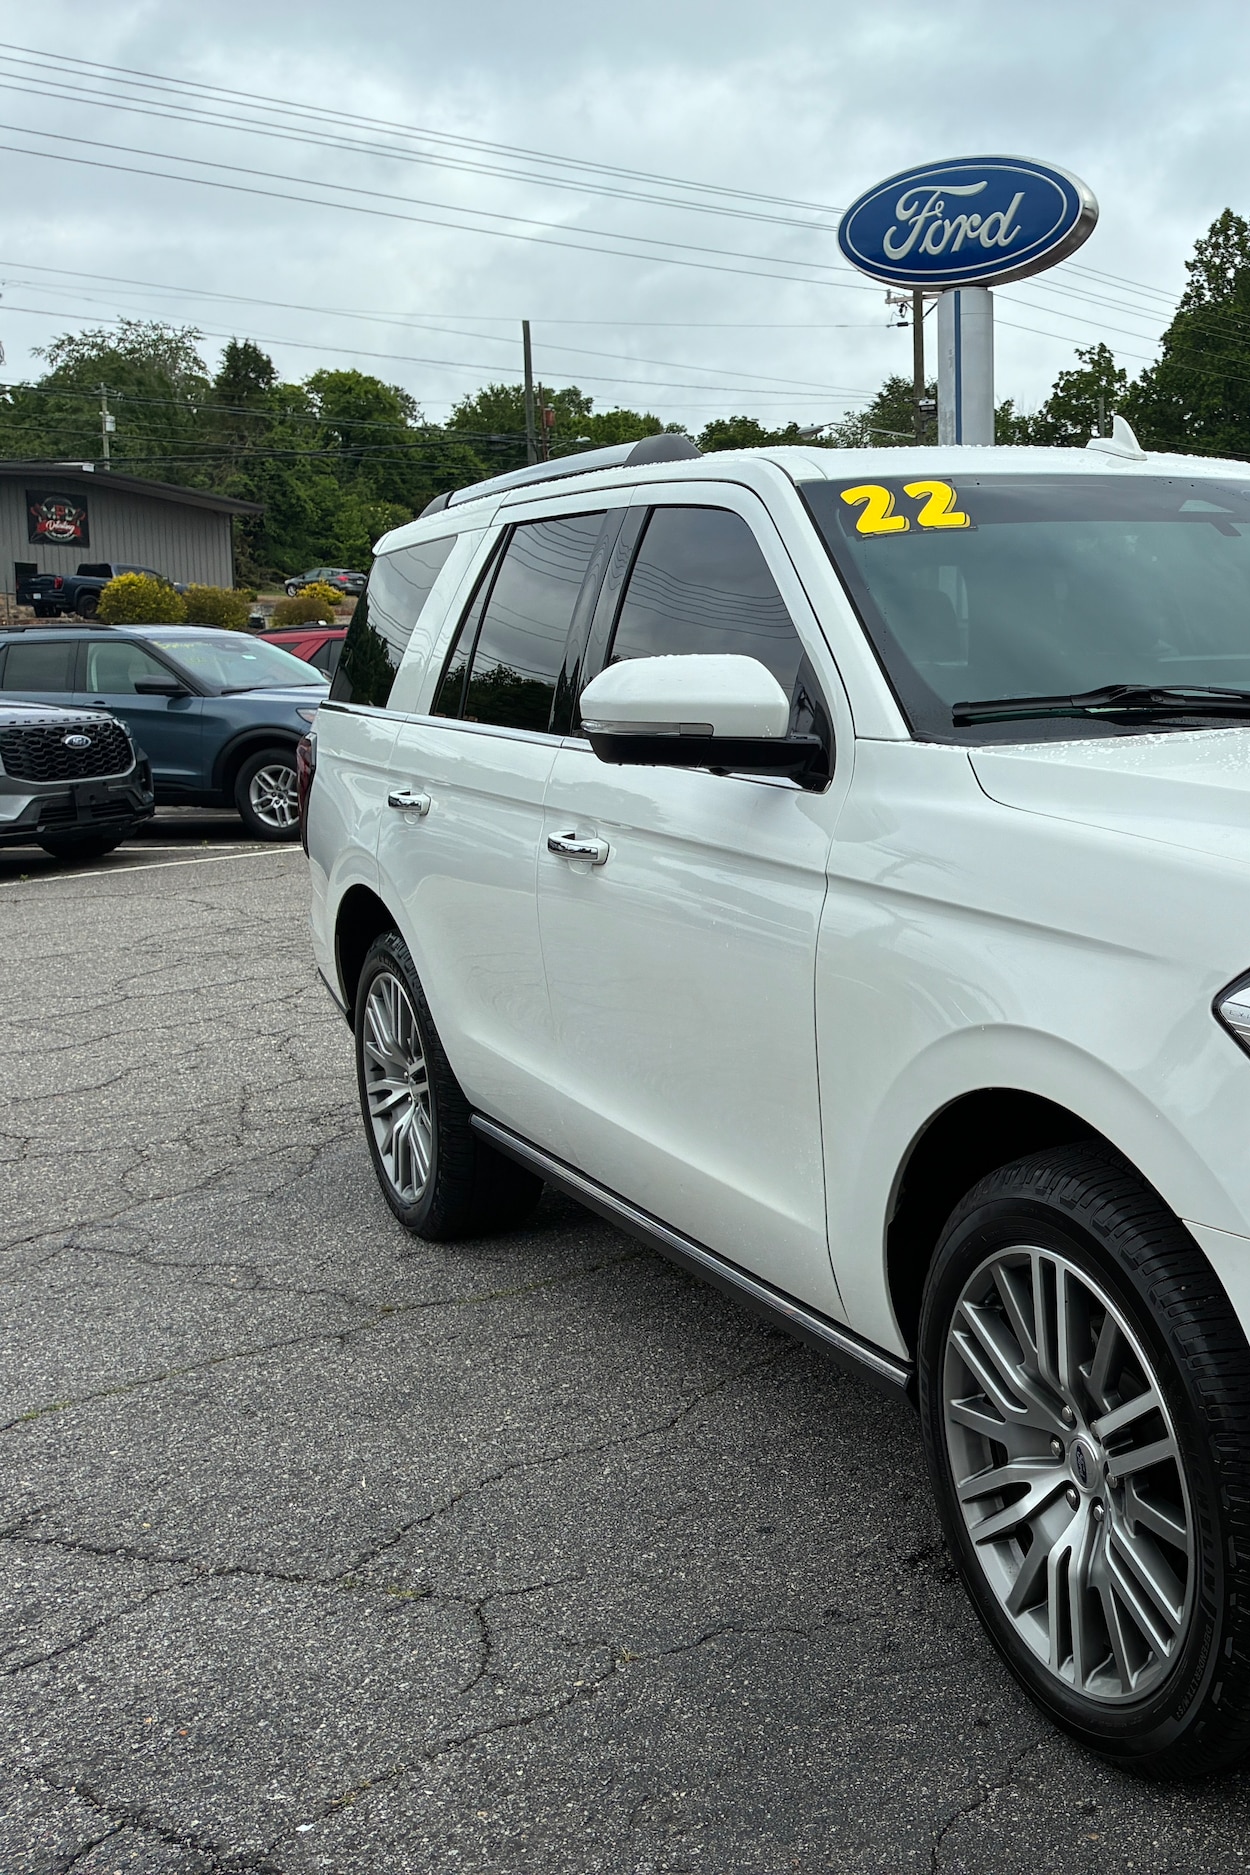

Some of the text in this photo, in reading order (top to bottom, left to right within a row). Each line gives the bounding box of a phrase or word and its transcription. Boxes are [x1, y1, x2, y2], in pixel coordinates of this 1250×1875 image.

[883, 180, 1025, 260] Ford
[840, 479, 970, 536] 22
[1193, 1624, 1213, 1680] DEFENDER
